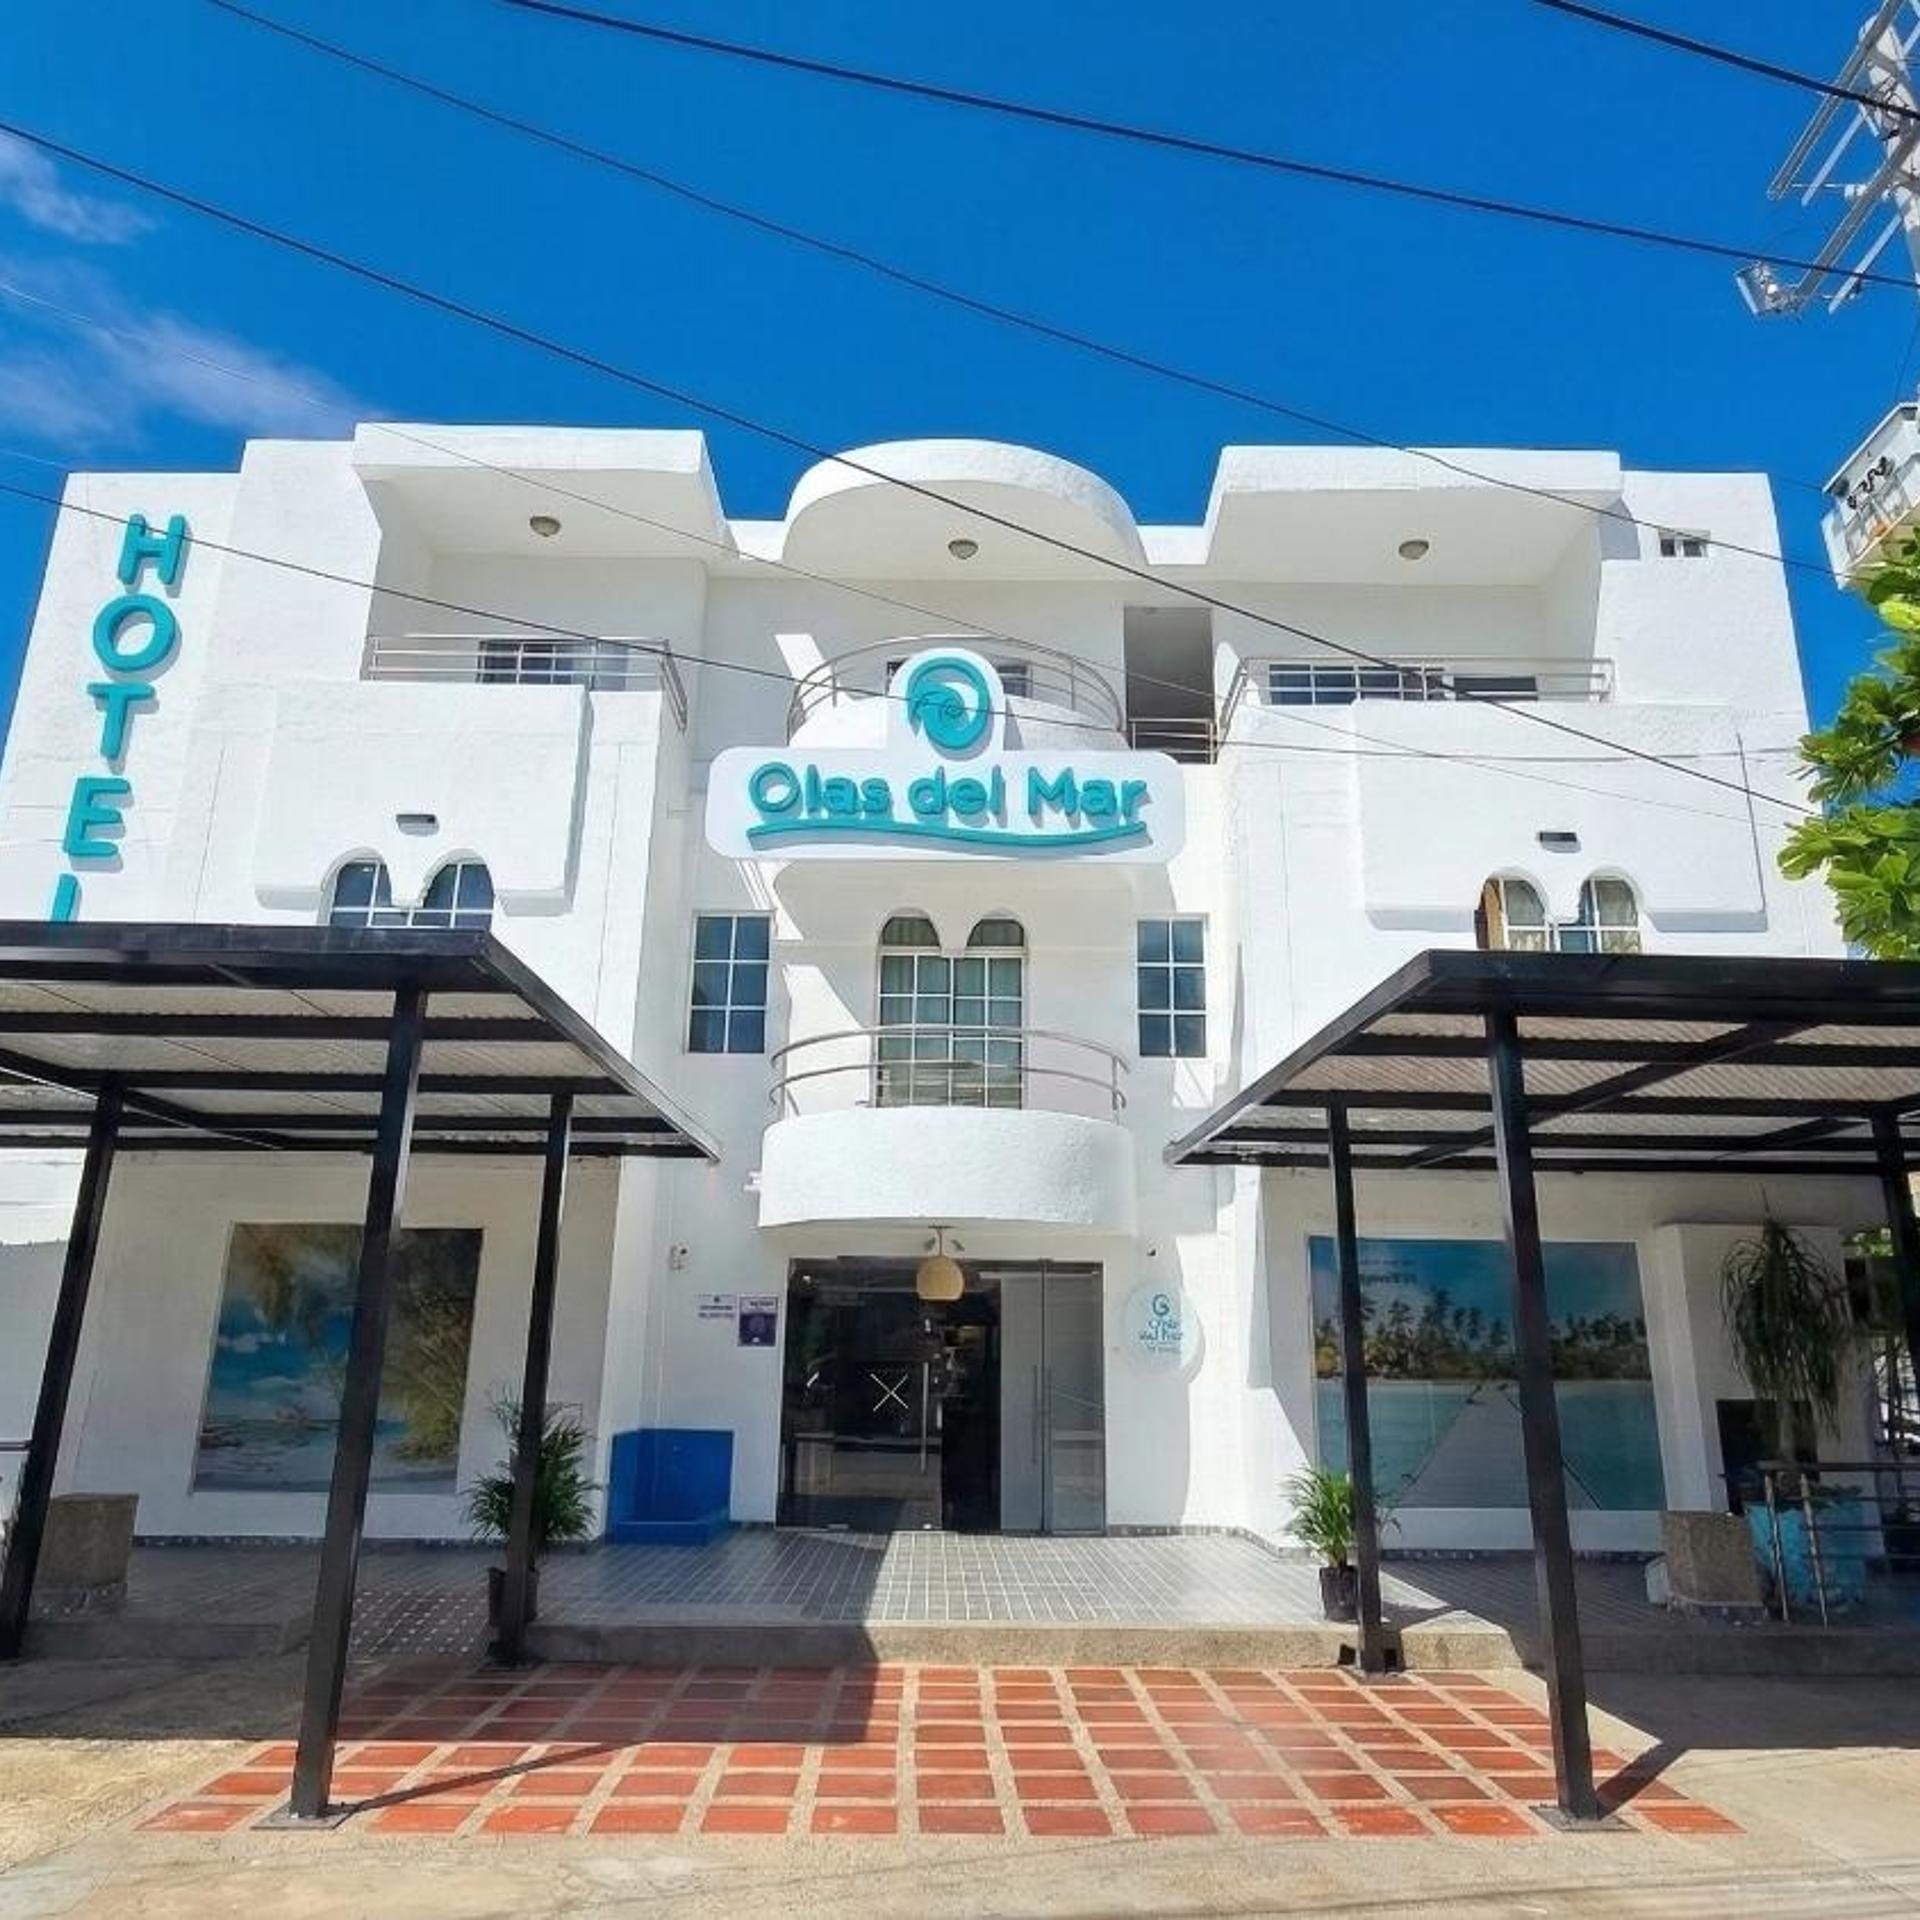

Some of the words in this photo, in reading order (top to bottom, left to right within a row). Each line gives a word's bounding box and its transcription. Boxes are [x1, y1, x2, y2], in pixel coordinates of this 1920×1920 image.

[748, 761, 890, 815] Olas
[908, 764, 1006, 815] del
[1027, 765, 1148, 816] Mar
